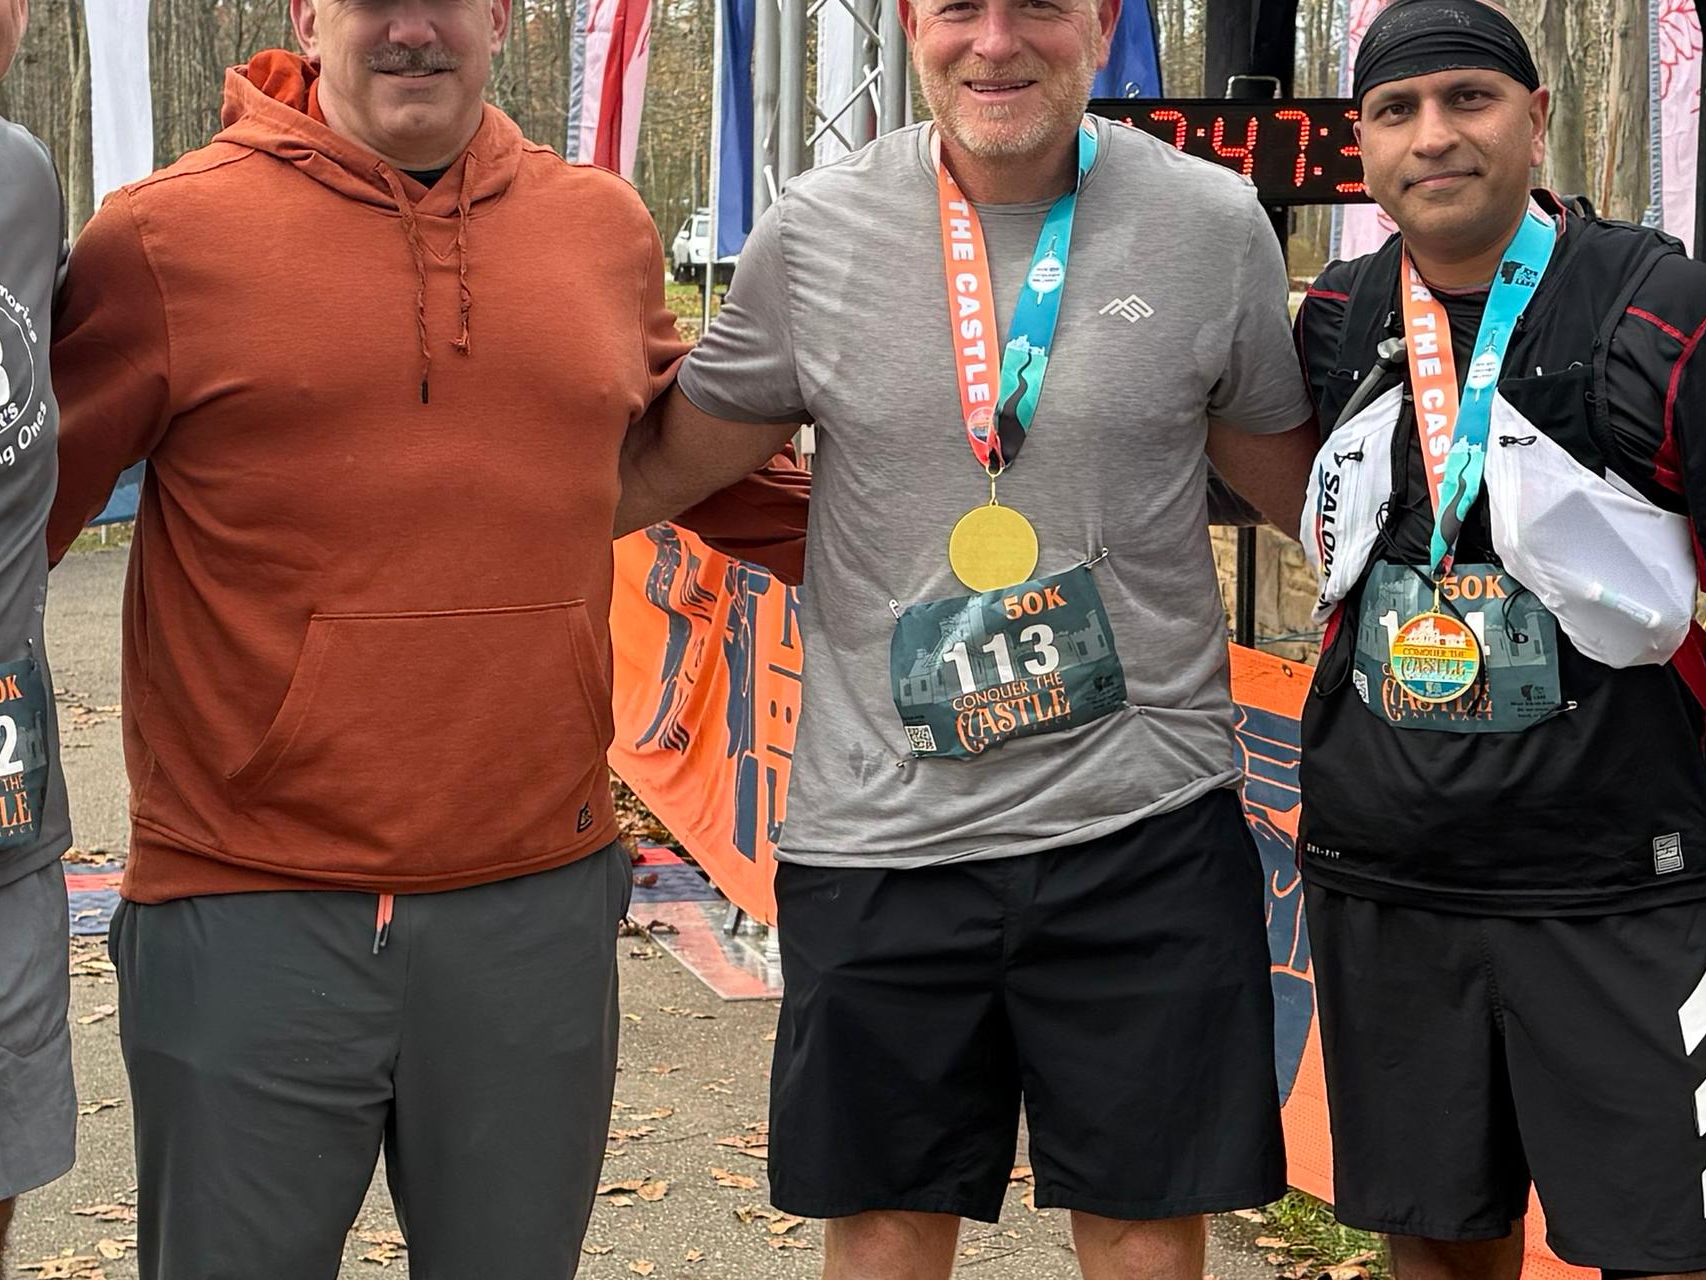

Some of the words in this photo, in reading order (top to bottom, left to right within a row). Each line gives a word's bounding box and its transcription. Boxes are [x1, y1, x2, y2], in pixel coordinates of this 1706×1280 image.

[948, 199, 975, 261] THE
[955, 273, 990, 404] CASTLE
[1412, 313, 1442, 378] THE
[1317, 471, 1341, 611] SALOMN
[1002, 585, 1068, 620] 50K
[1443, 575, 1508, 601] 50K
[942, 623, 1060, 695] 113
[951, 681, 1029, 712] CONQUER
[1033, 671, 1064, 690] THE
[955, 686, 1072, 754] CASTLE
[1, 772, 25, 793] THE
